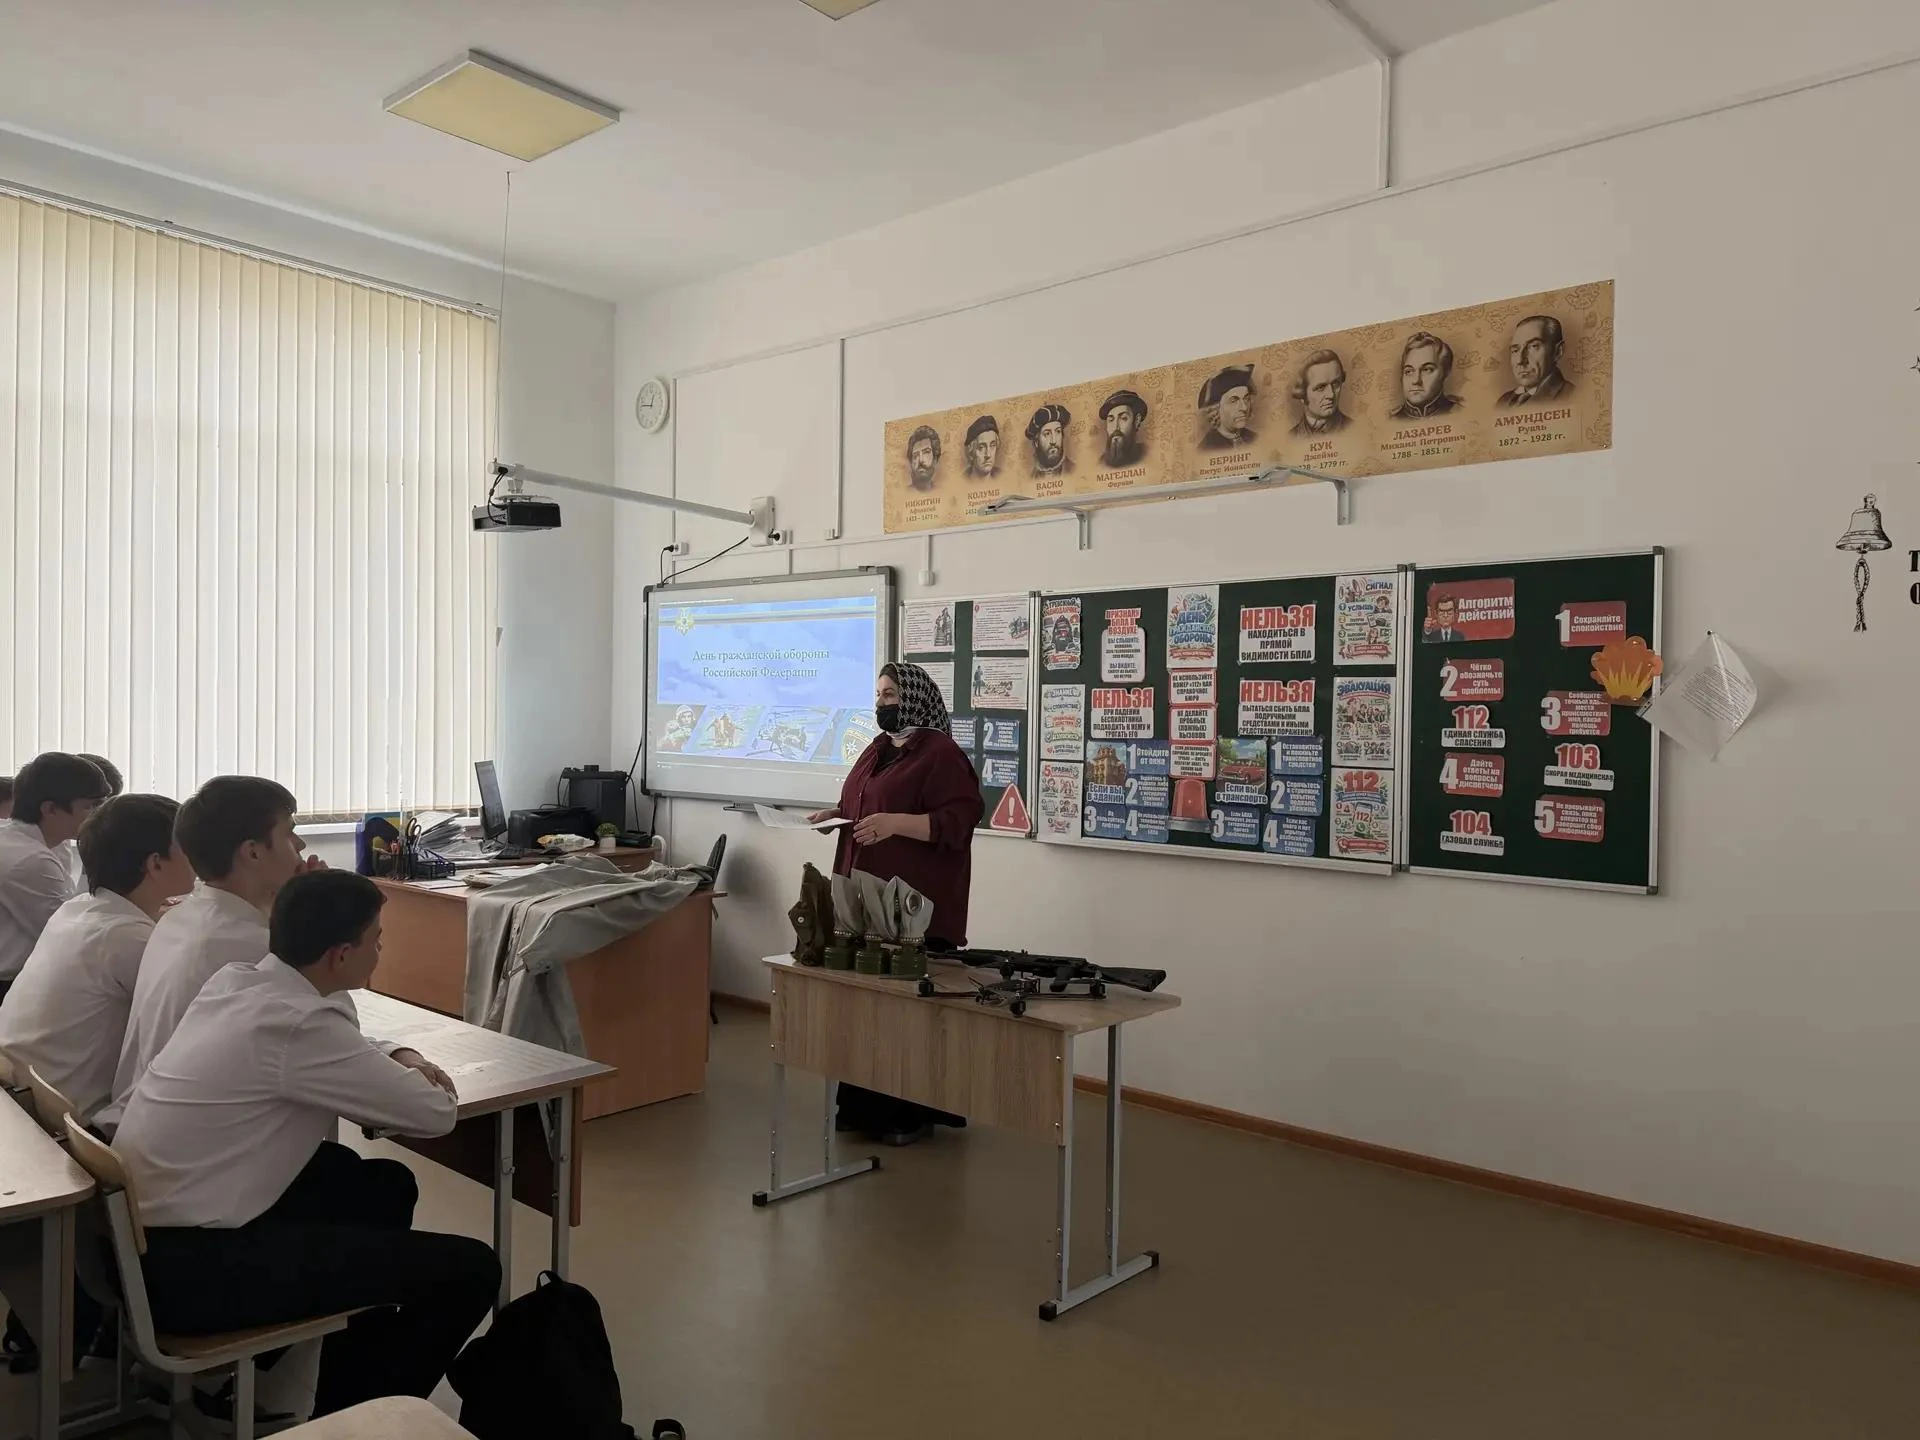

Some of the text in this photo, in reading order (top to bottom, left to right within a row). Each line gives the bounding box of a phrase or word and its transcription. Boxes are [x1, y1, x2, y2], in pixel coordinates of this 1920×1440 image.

[1494, 409, 1571, 428] АМУНДСЕН
[1393, 424, 1452, 440] ЛАЗАРЕВ
[1518, 425, 1547, 434] Руаль
[1310, 441, 1332, 452] КУК
[1380, 434, 1466, 452] Михаил Петрович
[1499, 438, 1519, 446] 1872
[1530, 434, 1552, 443] 1928
[1210, 452, 1251, 466] БЕРИНГ
[1304, 450, 1338, 462] Джеймс
[1392, 450, 1411, 460] 1788
[1422, 447, 1440, 456] 1851
[1096, 468, 1146, 482] МАГЕЛЛАН
[1036, 480, 1064, 490] ВАСКО
[968, 489, 1000, 500] КОЛУМБ
[905, 498, 940, 508] НИКИТИН
[1366, 582, 1393, 591] СИГНАЛ
[1458, 596, 1514, 609] Алгоритм
[1242, 606, 1314, 630] НЕЛЬЗЯ
[1458, 606, 1514, 623] действий
[1574, 614, 1621, 624] Сохраняйте
[1108, 626, 1137, 636] ВОЗДУХЕ
[1555, 610, 1570, 641] 1
[1571, 623, 1623, 632] спокойствие
[1174, 634, 1212, 644] ОБОРОНЫ
[1248, 628, 1305, 640] НАХОДИТЬСЯ В
[1260, 638, 1292, 649] ПРЯМОЙ
[692, 648, 830, 664] День гражданской обороны
[1242, 650, 1312, 662] ВИДИМОСТИ БПЛА
[702, 666, 818, 680] Российской Федерации
[1440, 666, 1458, 697] 2
[1241, 682, 1313, 702] НЕЛЬЗЯ
[1337, 682, 1391, 696] ЭВАКУАЦИЯ
[1092, 688, 1153, 708] НЕЛЬЗЯ
[1454, 706, 1489, 729] 112
[1541, 697, 1561, 730] 3
[984, 722, 994, 747] 2
[1473, 730, 1503, 740] СЛУЖБА
[1454, 738, 1492, 747] СПАСЕНИЯ
[1127, 744, 1136, 770] 1
[1272, 742, 1282, 769] 1
[1556, 745, 1599, 770] 103
[982, 759, 993, 782] 4
[1439, 759, 1458, 789] 4
[1545, 770, 1614, 781] СКОРАЯ МЕДИЦИНСКАЯ
[1089, 783, 1122, 794] Если вы
[1225, 784, 1257, 793] Если вы
[1343, 771, 1379, 792] 112
[1564, 779, 1592, 787] ПОМОЩЬ
[1094, 794, 1124, 802] здании
[1125, 778, 1138, 804] 2
[1271, 780, 1286, 808] 2
[1222, 794, 1266, 803] транспорте
[1084, 806, 1096, 832] 3
[1125, 810, 1138, 835] 4
[1211, 809, 1224, 838] 3
[1356, 812, 1370, 822] 112
[1452, 812, 1490, 834] 104
[1534, 800, 1555, 834] 5
[1263, 820, 1278, 848] 4
[1442, 835, 1504, 848] ГАЗОВАЯ СЛУЖБА
